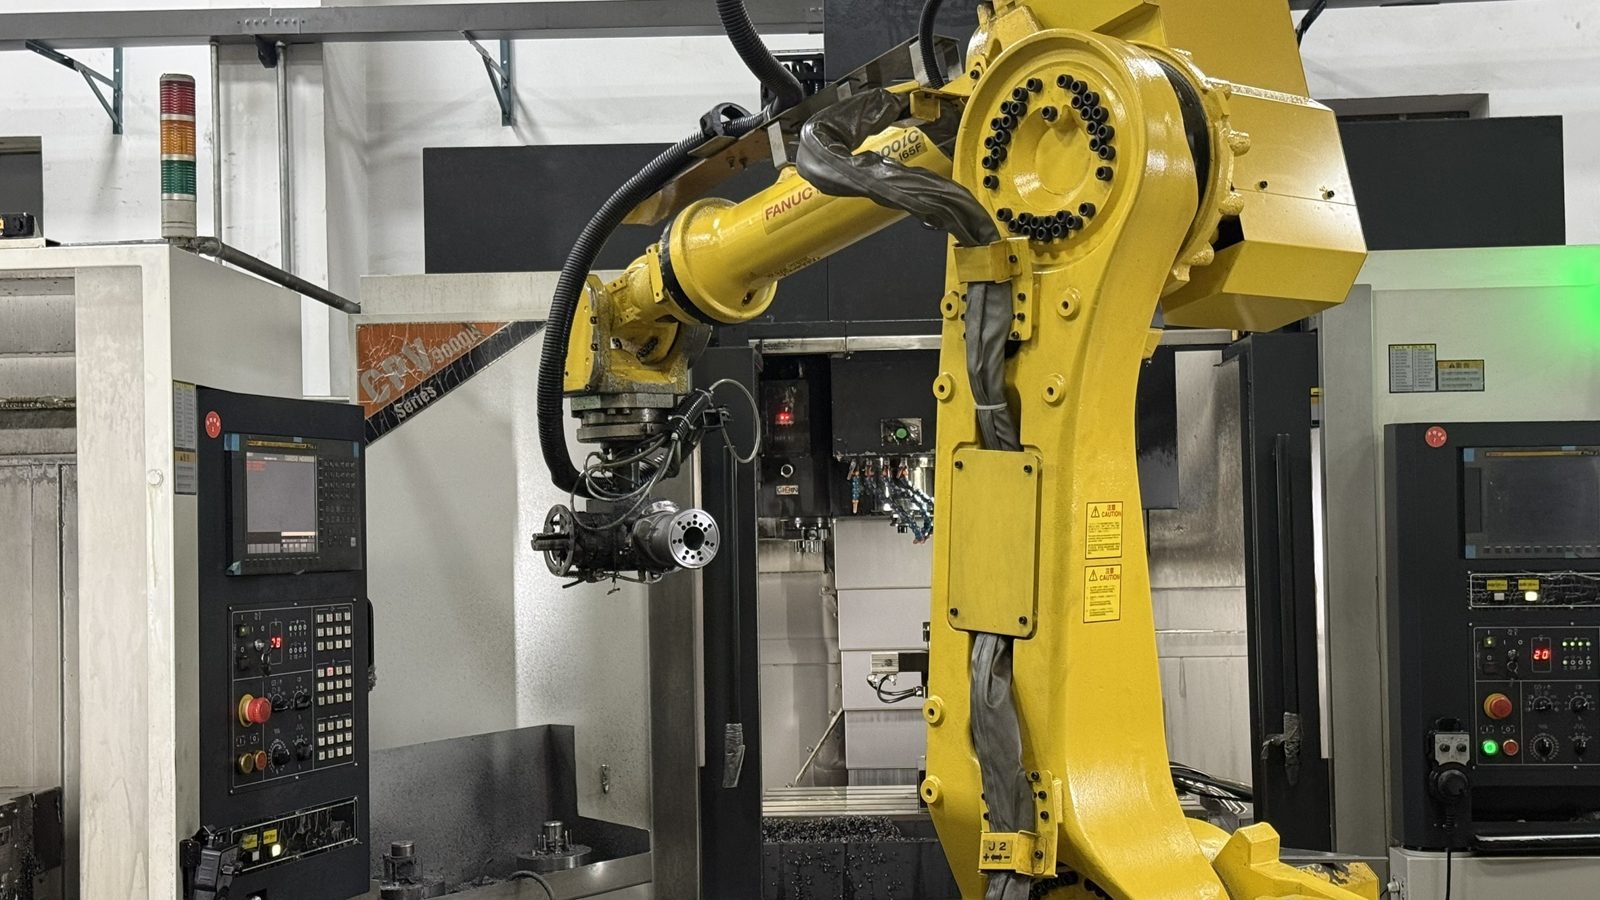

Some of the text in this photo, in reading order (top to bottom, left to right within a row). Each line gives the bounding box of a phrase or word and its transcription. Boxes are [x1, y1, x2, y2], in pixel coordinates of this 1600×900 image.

[765, 187, 813, 220] FANUC
[393, 386, 437, 419] Series
[1533, 649, 1550, 660] 20
